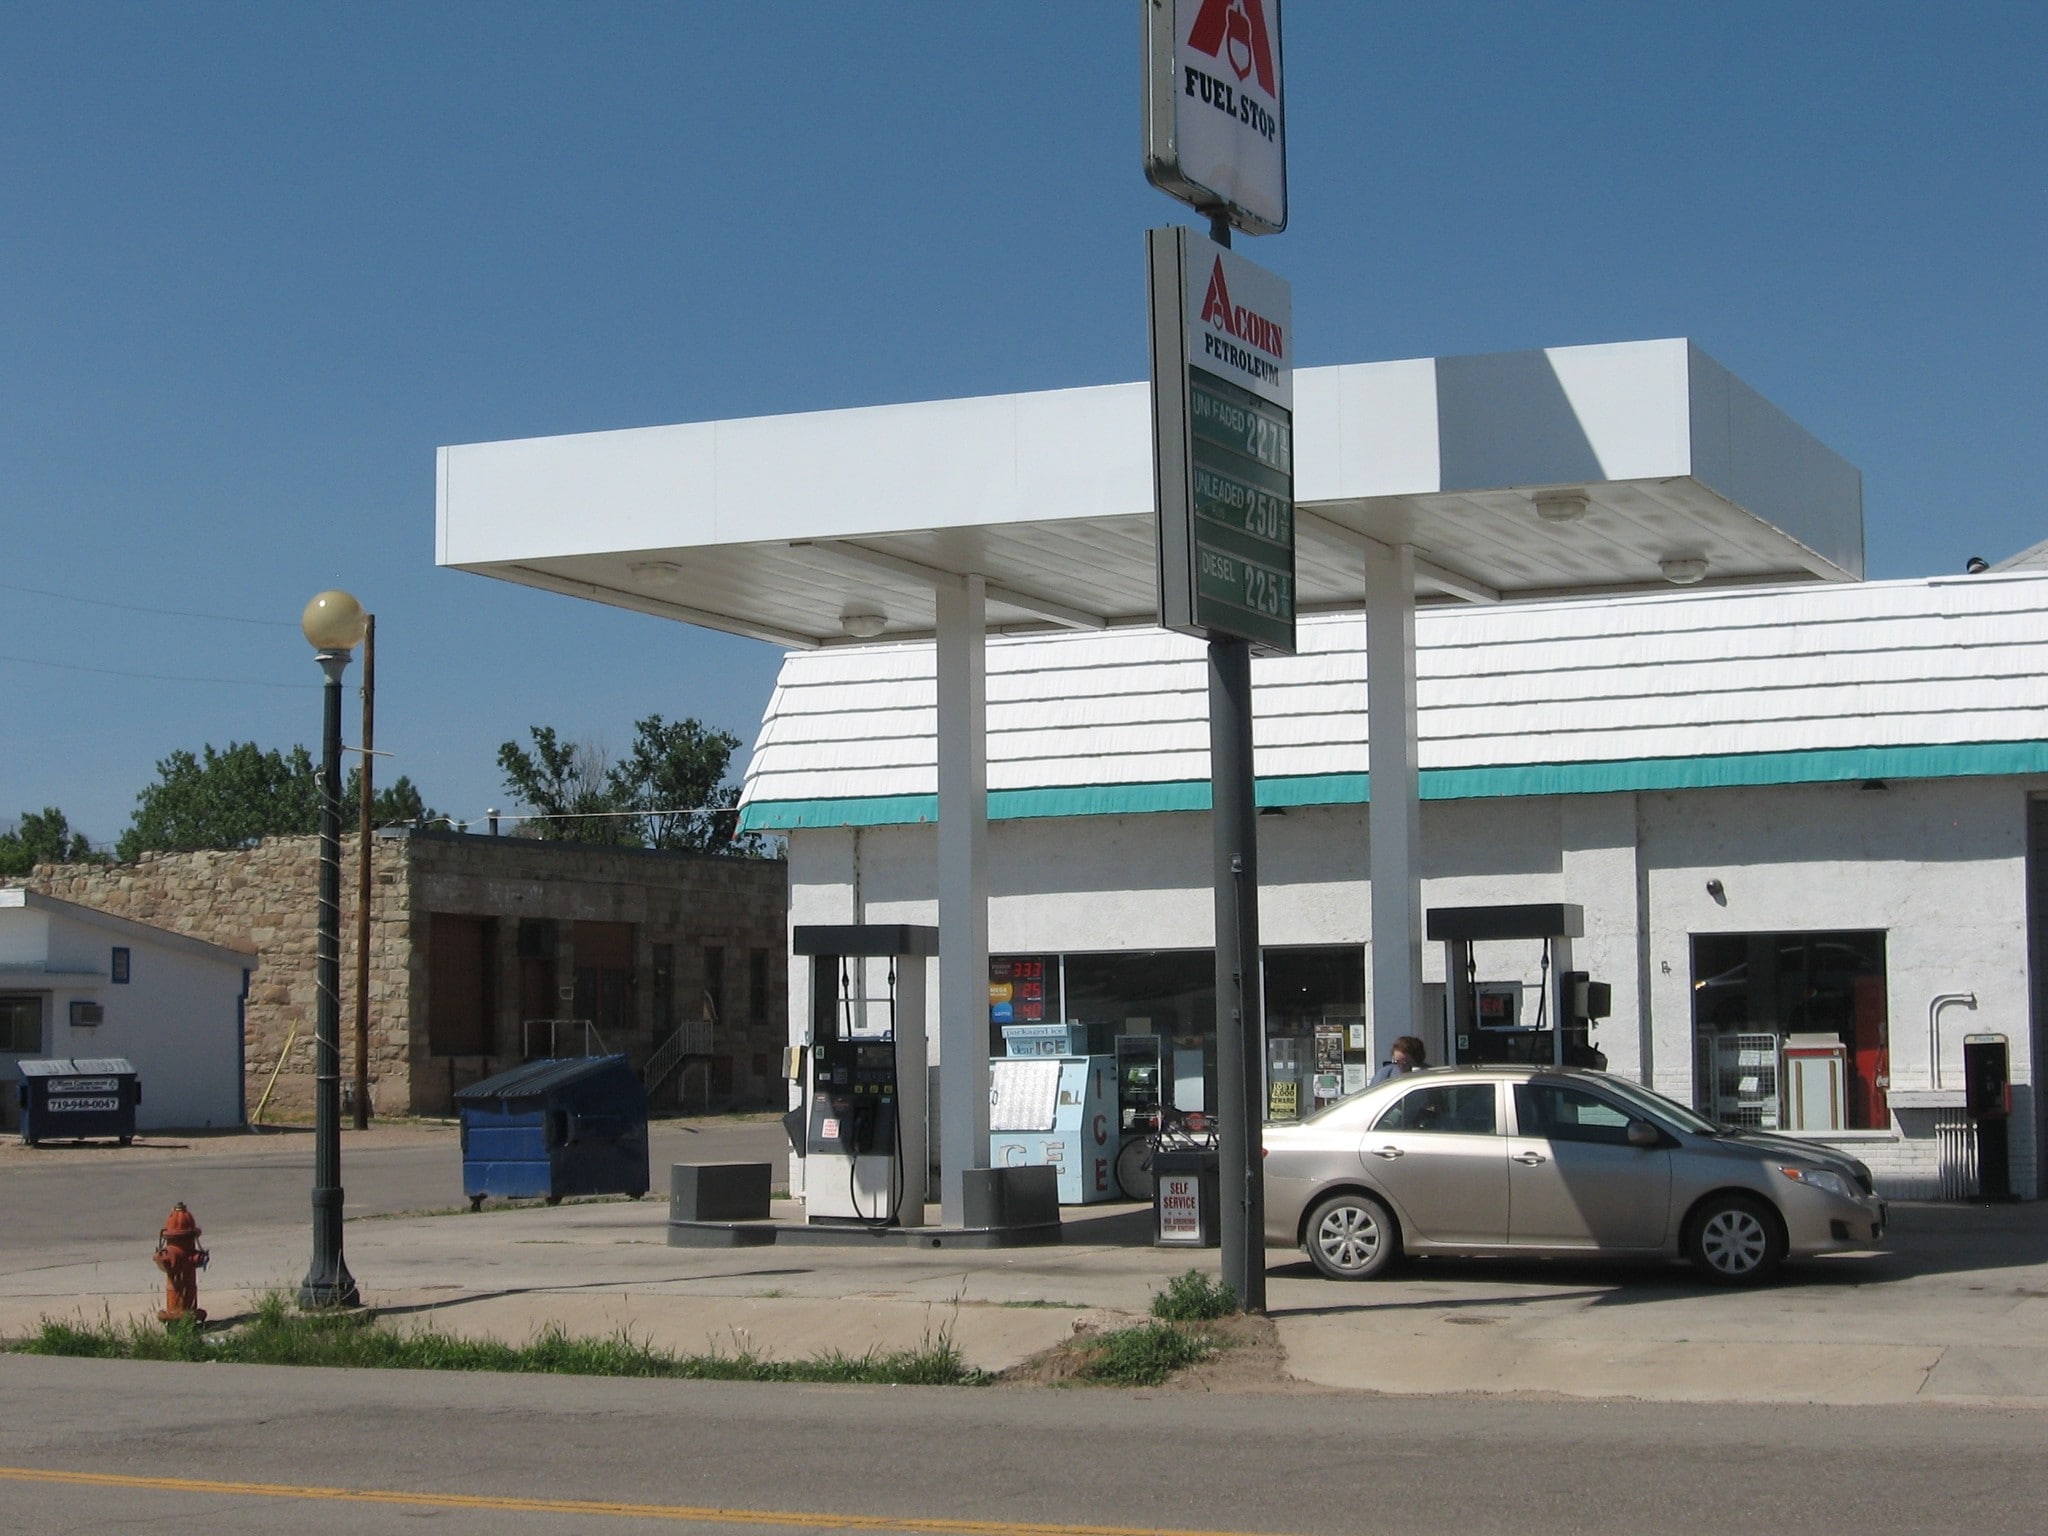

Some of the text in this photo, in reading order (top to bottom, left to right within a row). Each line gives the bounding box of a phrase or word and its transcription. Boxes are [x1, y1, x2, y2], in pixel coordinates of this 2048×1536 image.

[1184, 65, 1276, 143] FUEL STOP
[1201, 253, 1283, 359] ACORN
[1204, 332, 1279, 387] PETROLEUM
[1246, 413, 1278, 464] 227
[1194, 470, 1244, 509] UNLEADED
[1245, 489, 1277, 539] 250
[1202, 552, 1236, 582] DIESEL
[1245, 565, 1278, 615] 225
[1035, 1040, 1066, 1055] ICE
[1163, 1196, 1196, 1209] SERVICE
[1170, 1182, 1189, 1195] SELF
